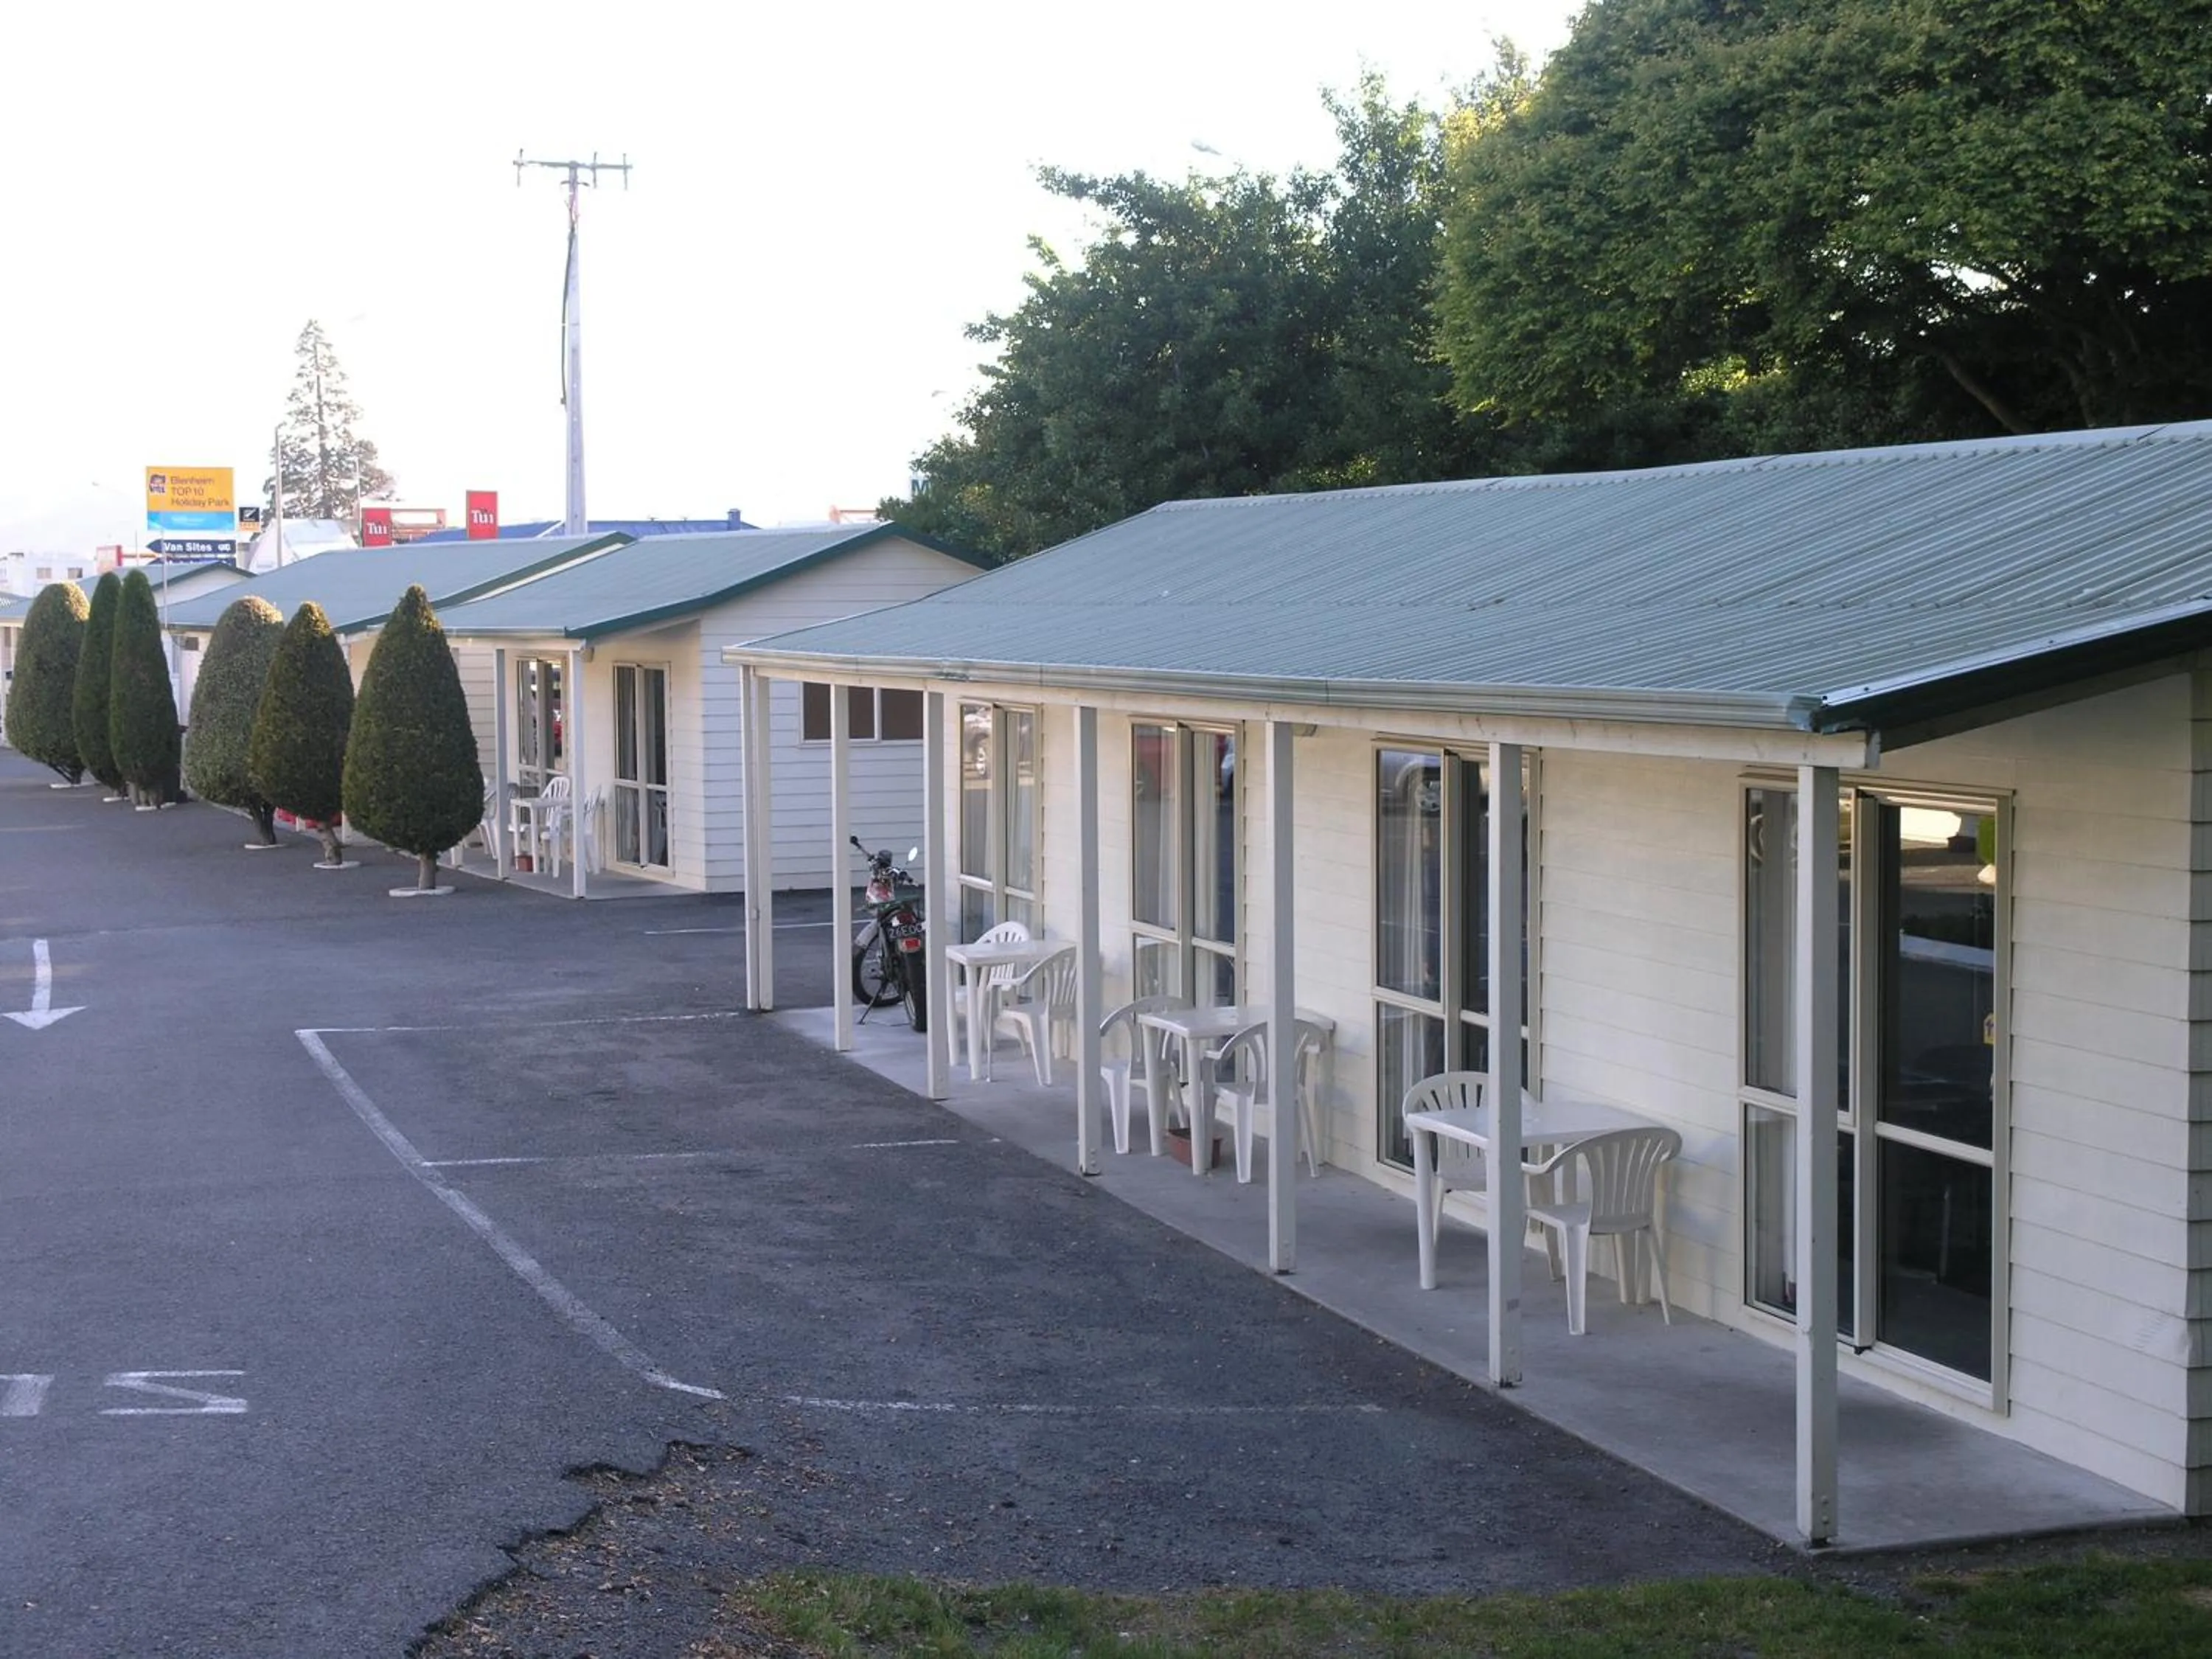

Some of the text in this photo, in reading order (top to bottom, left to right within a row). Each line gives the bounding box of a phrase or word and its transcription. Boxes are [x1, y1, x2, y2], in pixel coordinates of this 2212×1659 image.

[171, 486, 204, 496] TOP 10
[171, 498, 229, 508] Holiday Park
[164, 542, 213, 552] Van Sites
